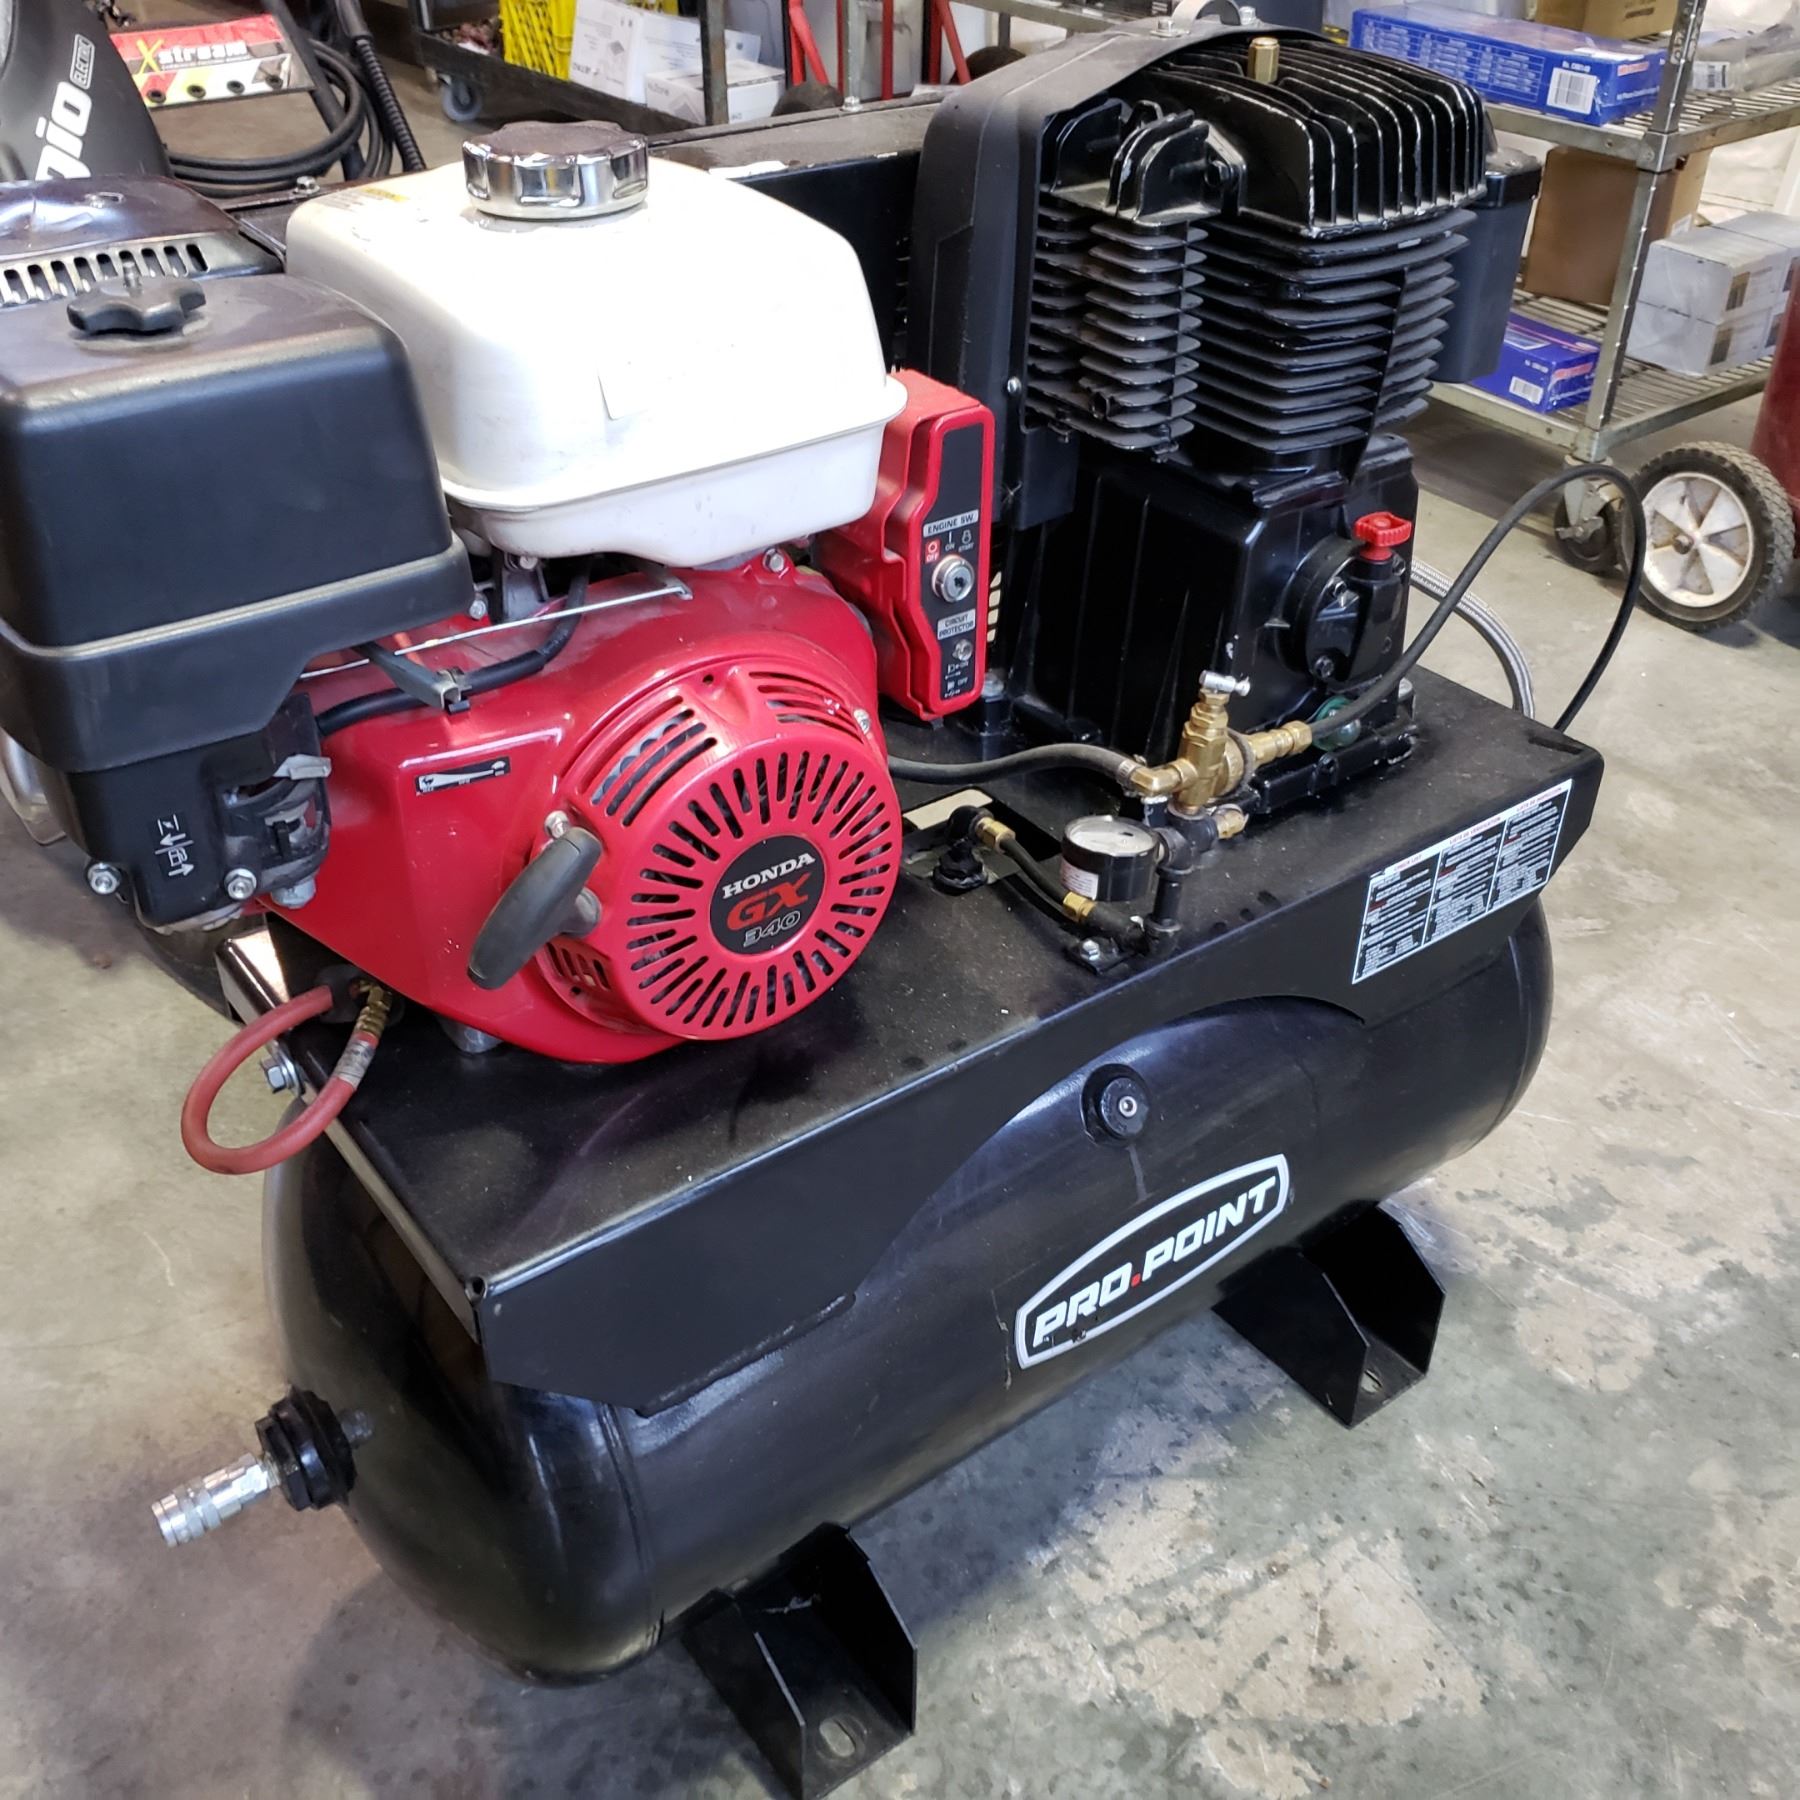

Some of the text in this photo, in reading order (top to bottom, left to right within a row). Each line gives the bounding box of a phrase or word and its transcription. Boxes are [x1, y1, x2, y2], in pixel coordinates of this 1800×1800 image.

[927, 518, 958, 534] ENGINE
[945, 542, 956, 551] ON
[926, 552, 940, 563] OFF
[939, 620, 975, 637] PROTECTOR
[722, 853, 816, 899] HONDA
[727, 872, 811, 931] GX
[742, 910, 802, 948] 340
